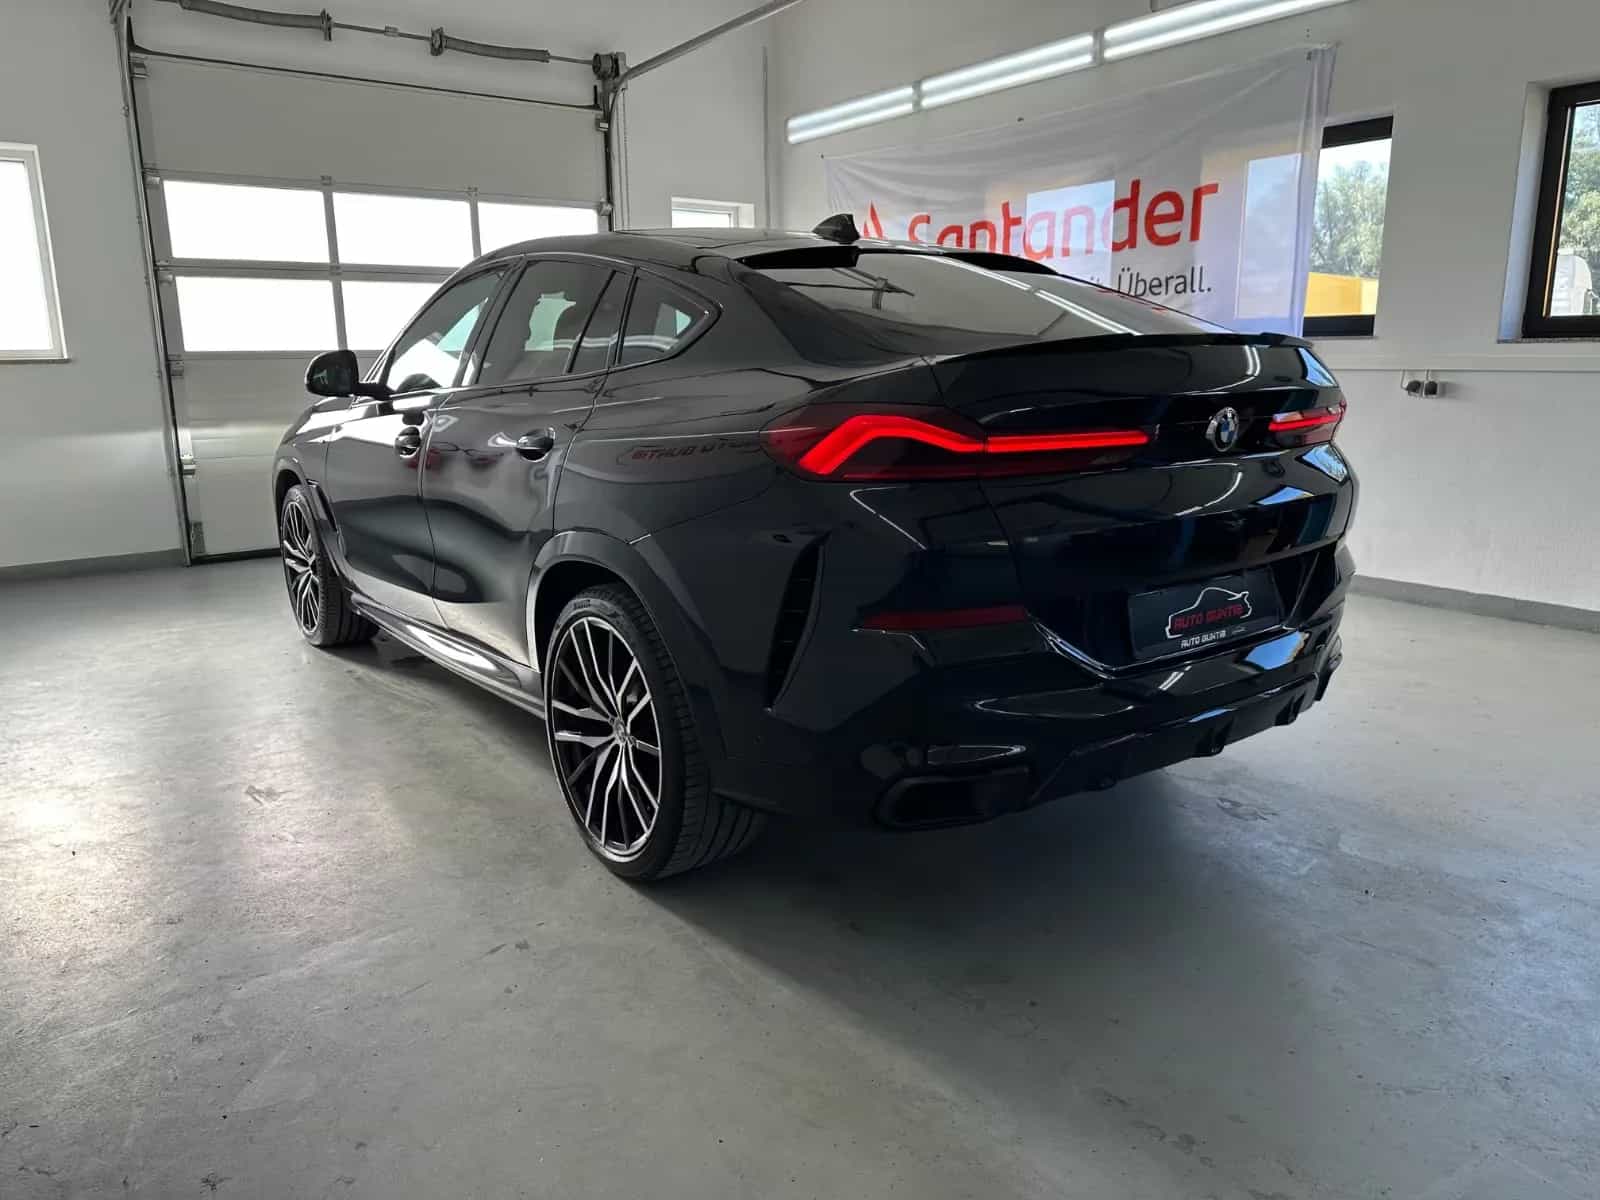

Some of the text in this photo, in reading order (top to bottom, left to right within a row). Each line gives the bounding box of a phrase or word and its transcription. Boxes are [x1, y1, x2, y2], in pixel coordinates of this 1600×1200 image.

[1117, 265, 1212, 297] Überall.
[1173, 613, 1202, 631] AUTO
[1181, 636, 1200, 648] AUTO
